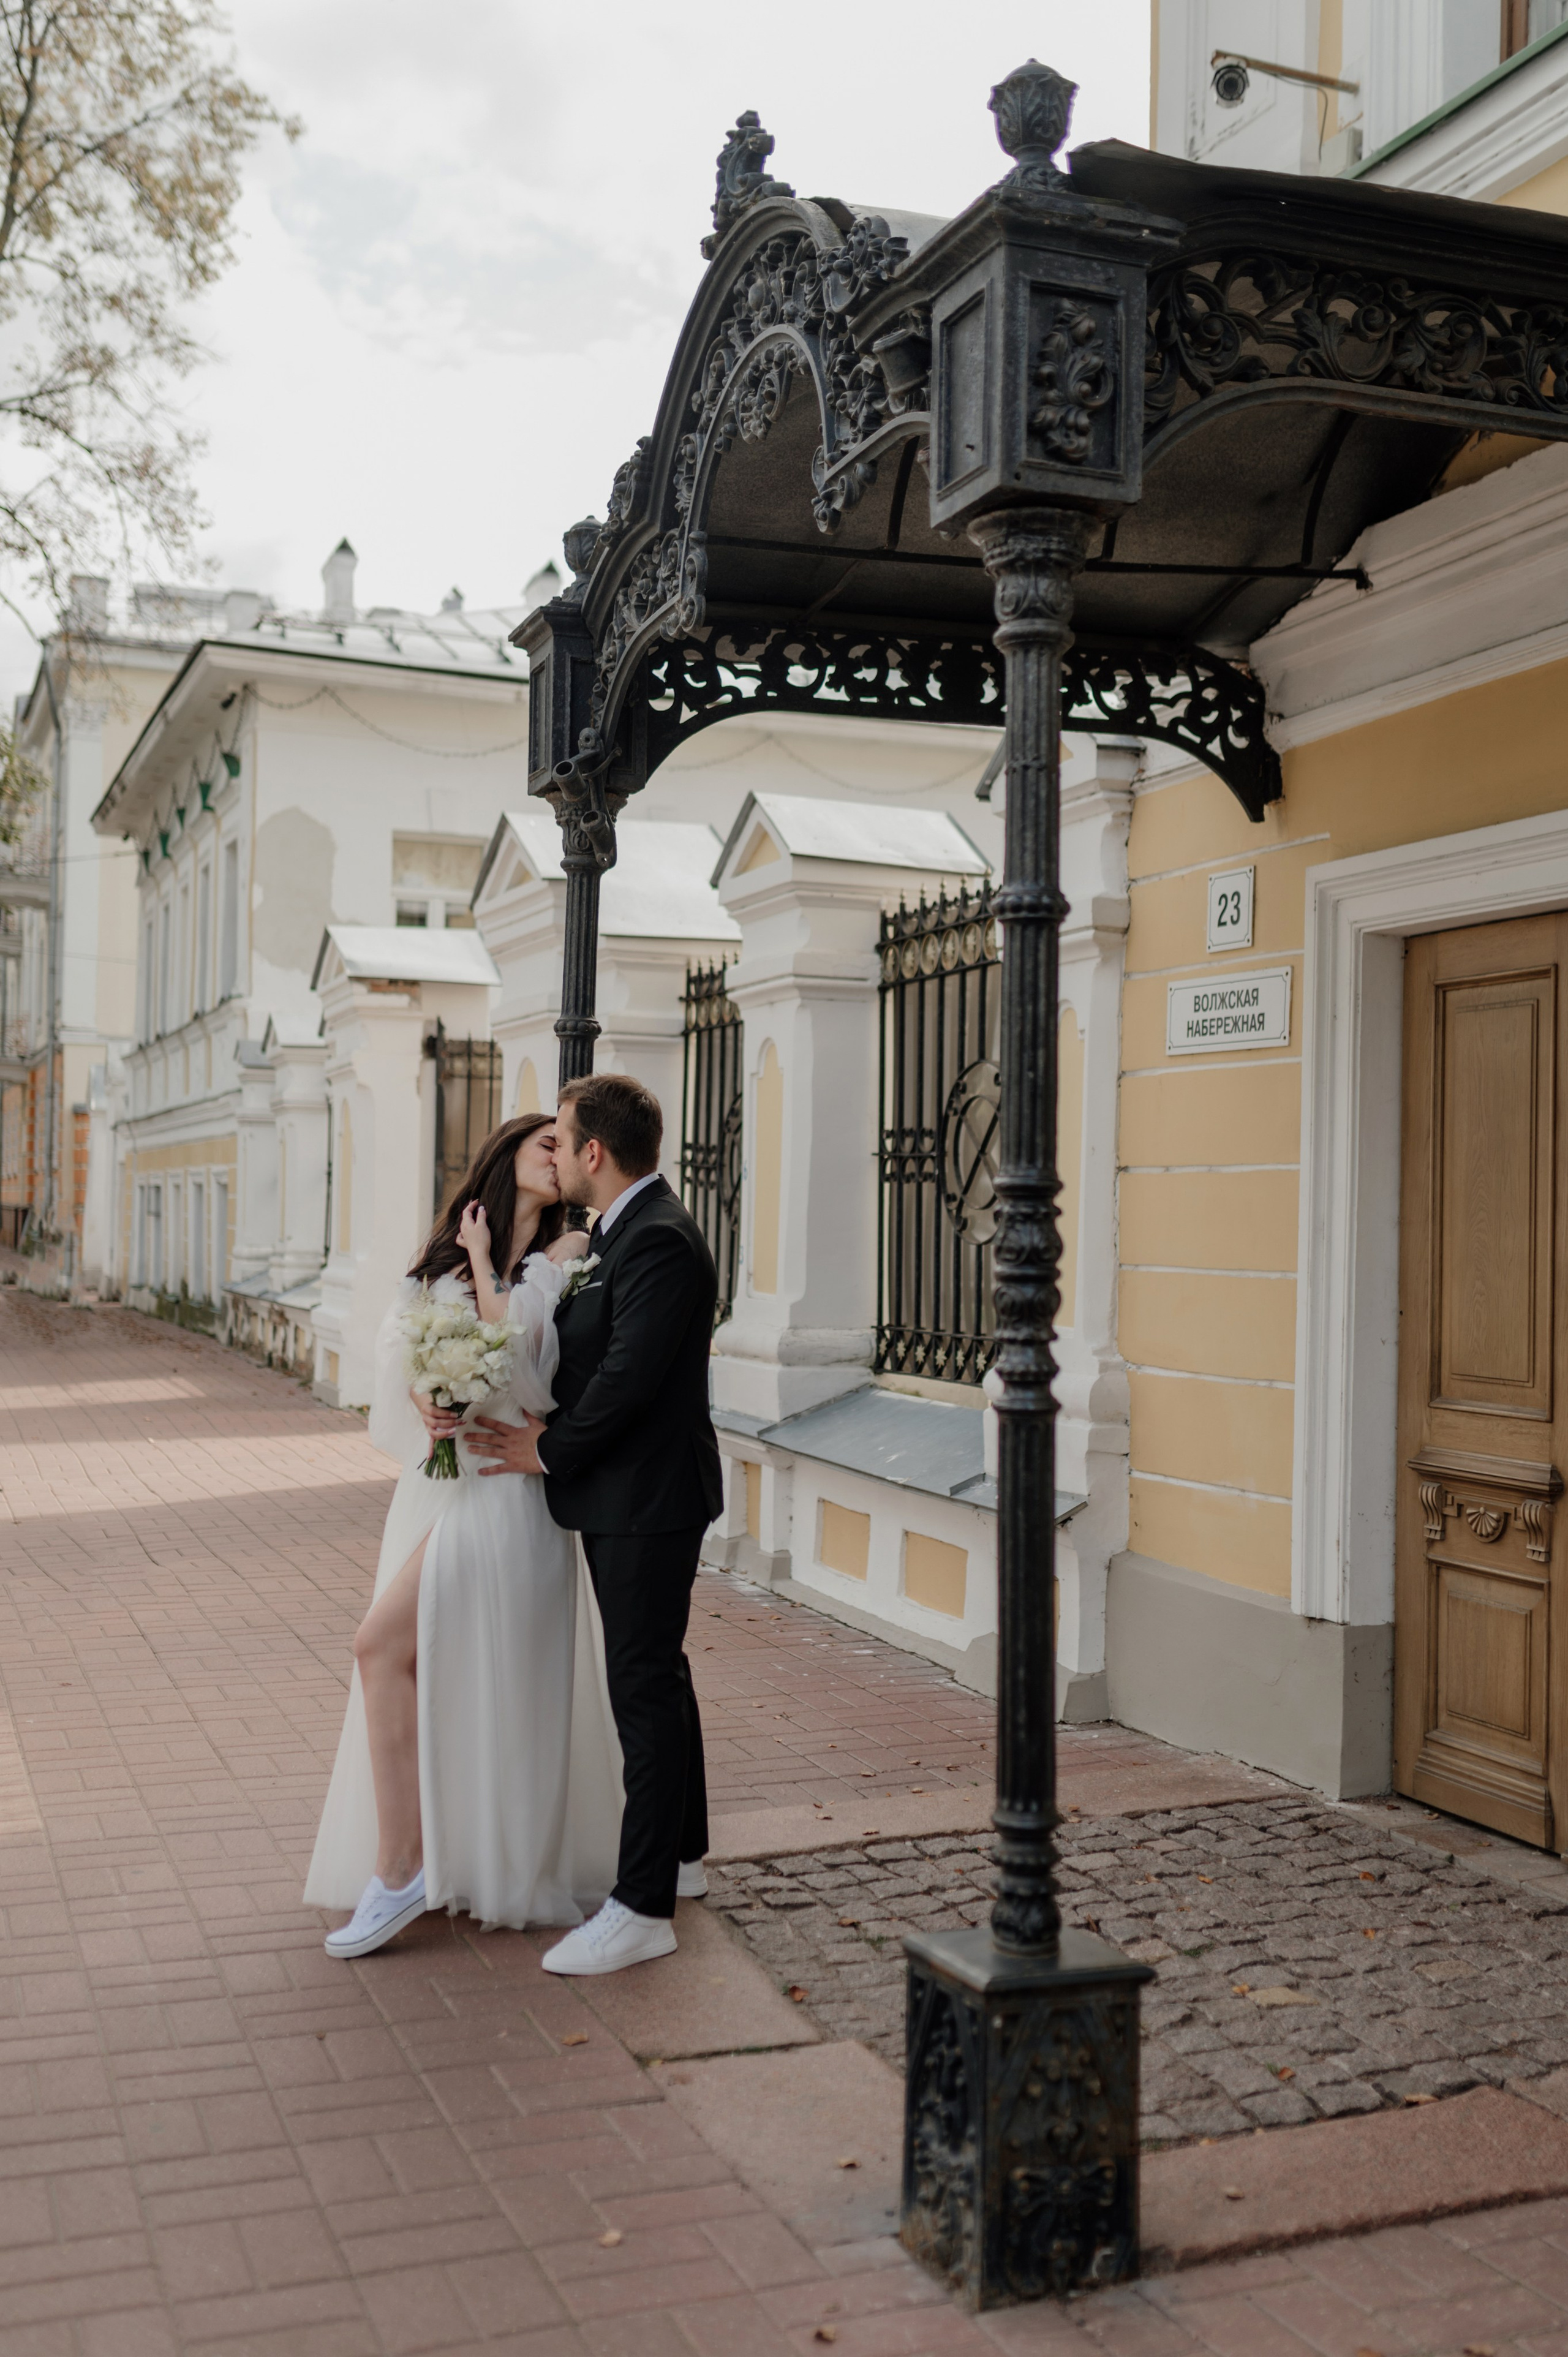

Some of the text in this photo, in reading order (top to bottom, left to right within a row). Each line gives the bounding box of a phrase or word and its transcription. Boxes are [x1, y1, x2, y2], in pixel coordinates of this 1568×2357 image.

[1217, 891, 1241, 927] 23
[1194, 987, 1259, 1013] ВОЛЖСКАЯ
[1186, 1013, 1265, 1038] НАБЕРЕЖНАЯ
